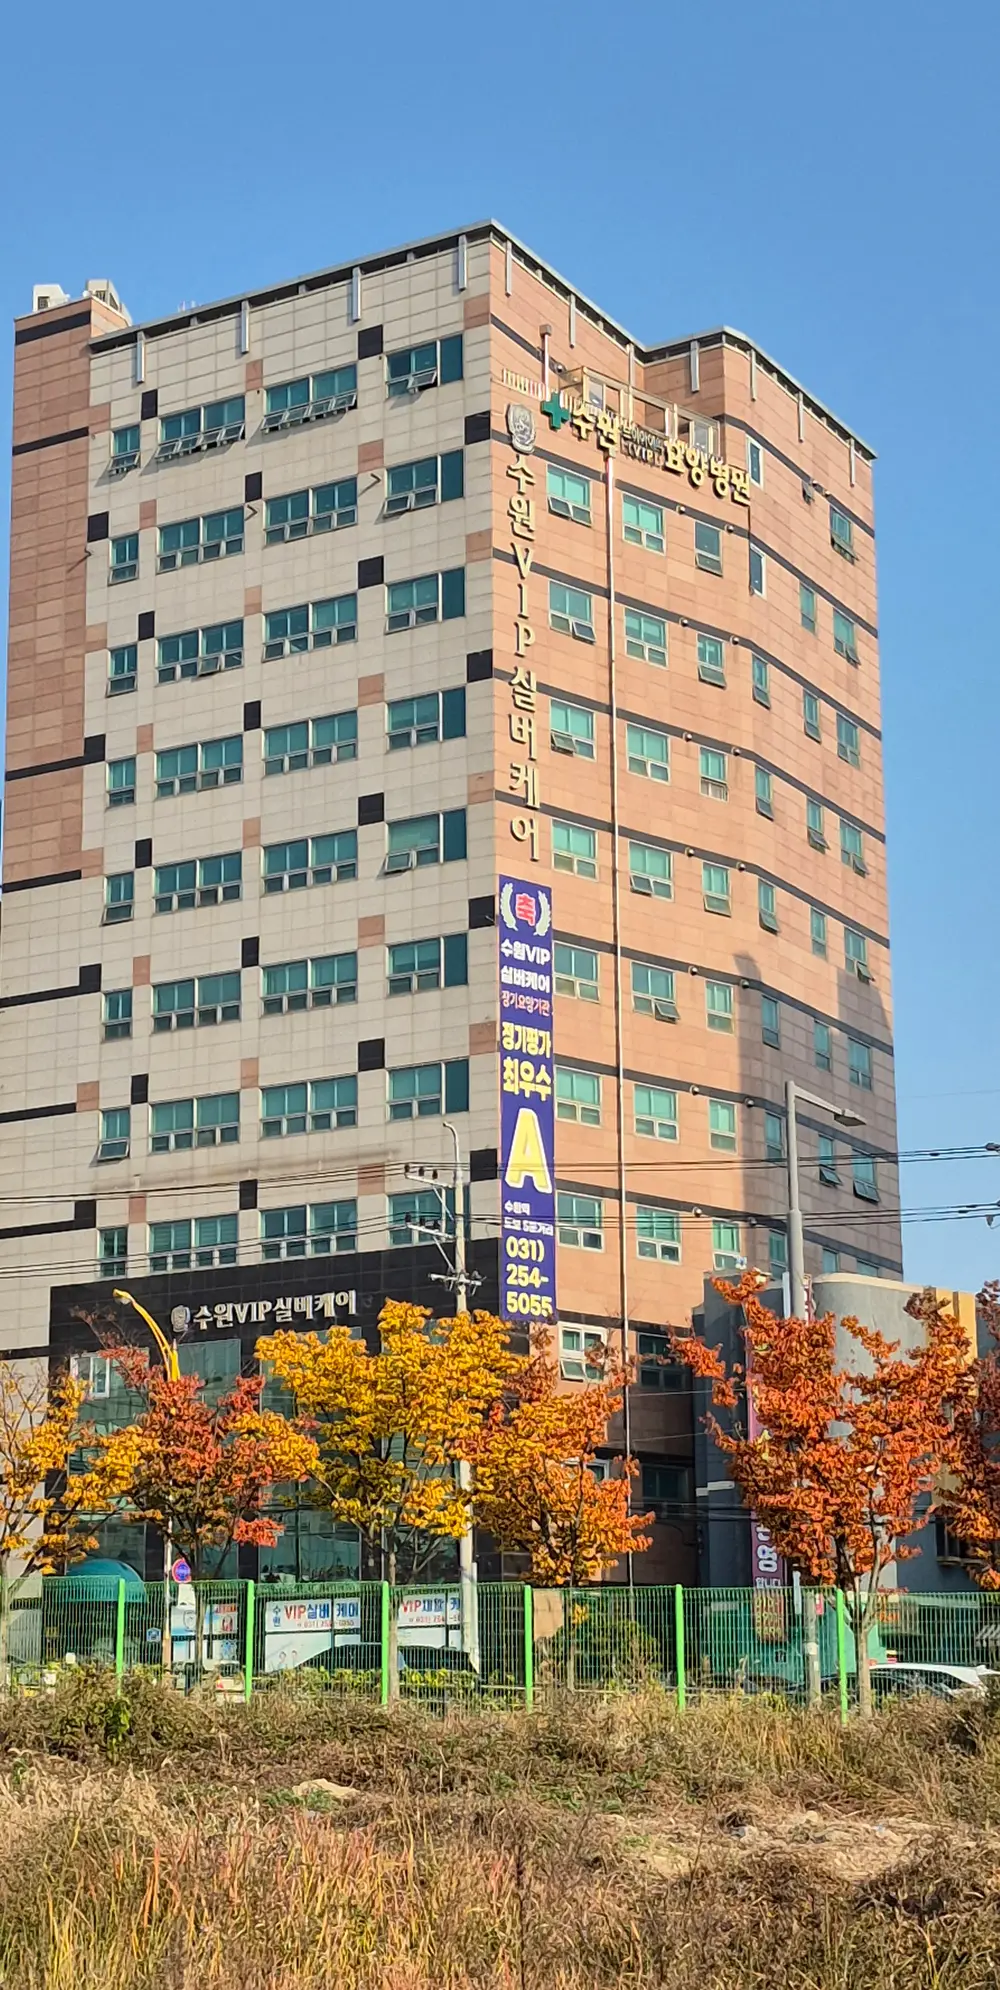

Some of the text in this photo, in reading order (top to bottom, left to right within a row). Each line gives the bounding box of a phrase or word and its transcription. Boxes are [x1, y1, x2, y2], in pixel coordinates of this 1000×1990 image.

[572, 400, 618, 449] 수원
[515, 893, 537, 927] 축
[501, 938, 551, 966] 수원VIP
[501, 965, 551, 994] 실버케어
[502, 1056, 552, 1101] 최우수
[505, 1107, 553, 1194] A
[505, 1235, 545, 1263] 031)
[505, 1263, 549, 1288] 254-
[193, 1289, 357, 1330] 수원VIP실버케어
[505, 1291, 553, 1318] 5055
